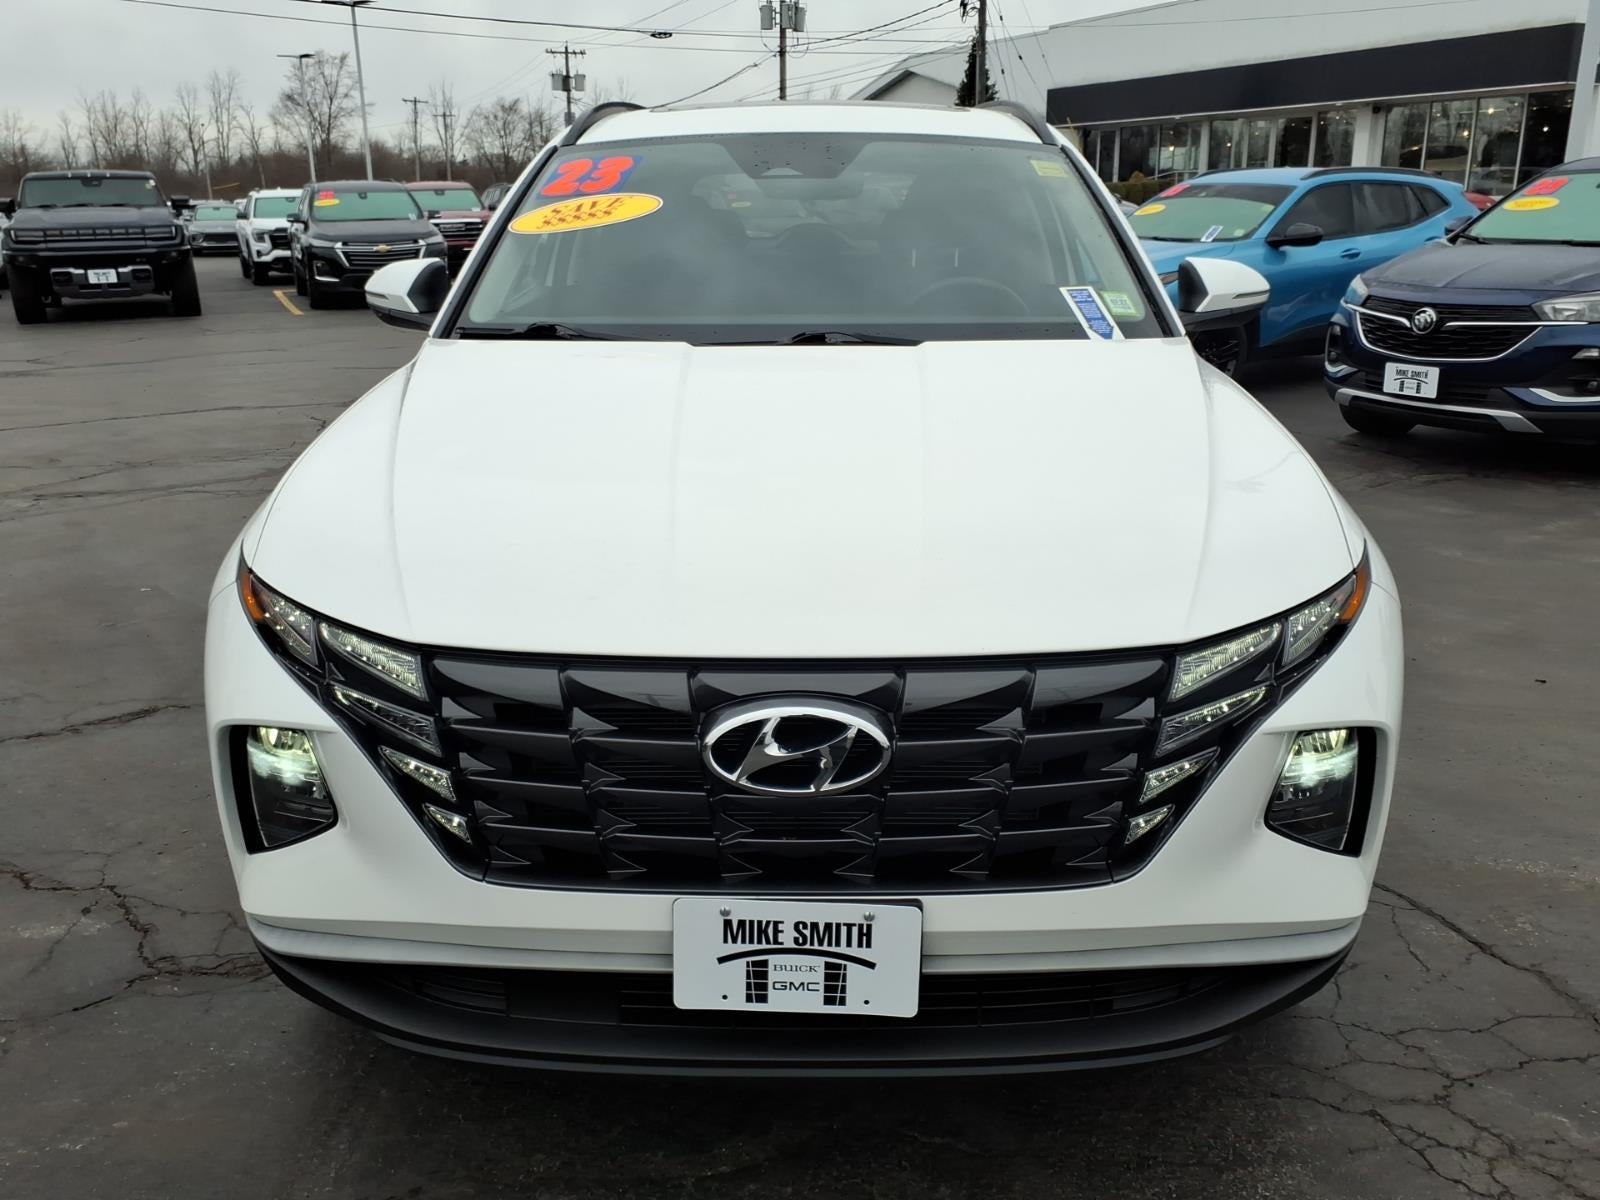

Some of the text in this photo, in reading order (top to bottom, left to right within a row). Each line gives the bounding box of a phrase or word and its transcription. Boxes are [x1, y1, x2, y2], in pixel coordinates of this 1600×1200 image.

[541, 156, 634, 196] 23
[1396, 369, 1428, 379] MIKE SMITH
[723, 919, 872, 948] MIKE SMITH
[773, 964, 820, 973] BUICK
[772, 980, 820, 992] GMC
